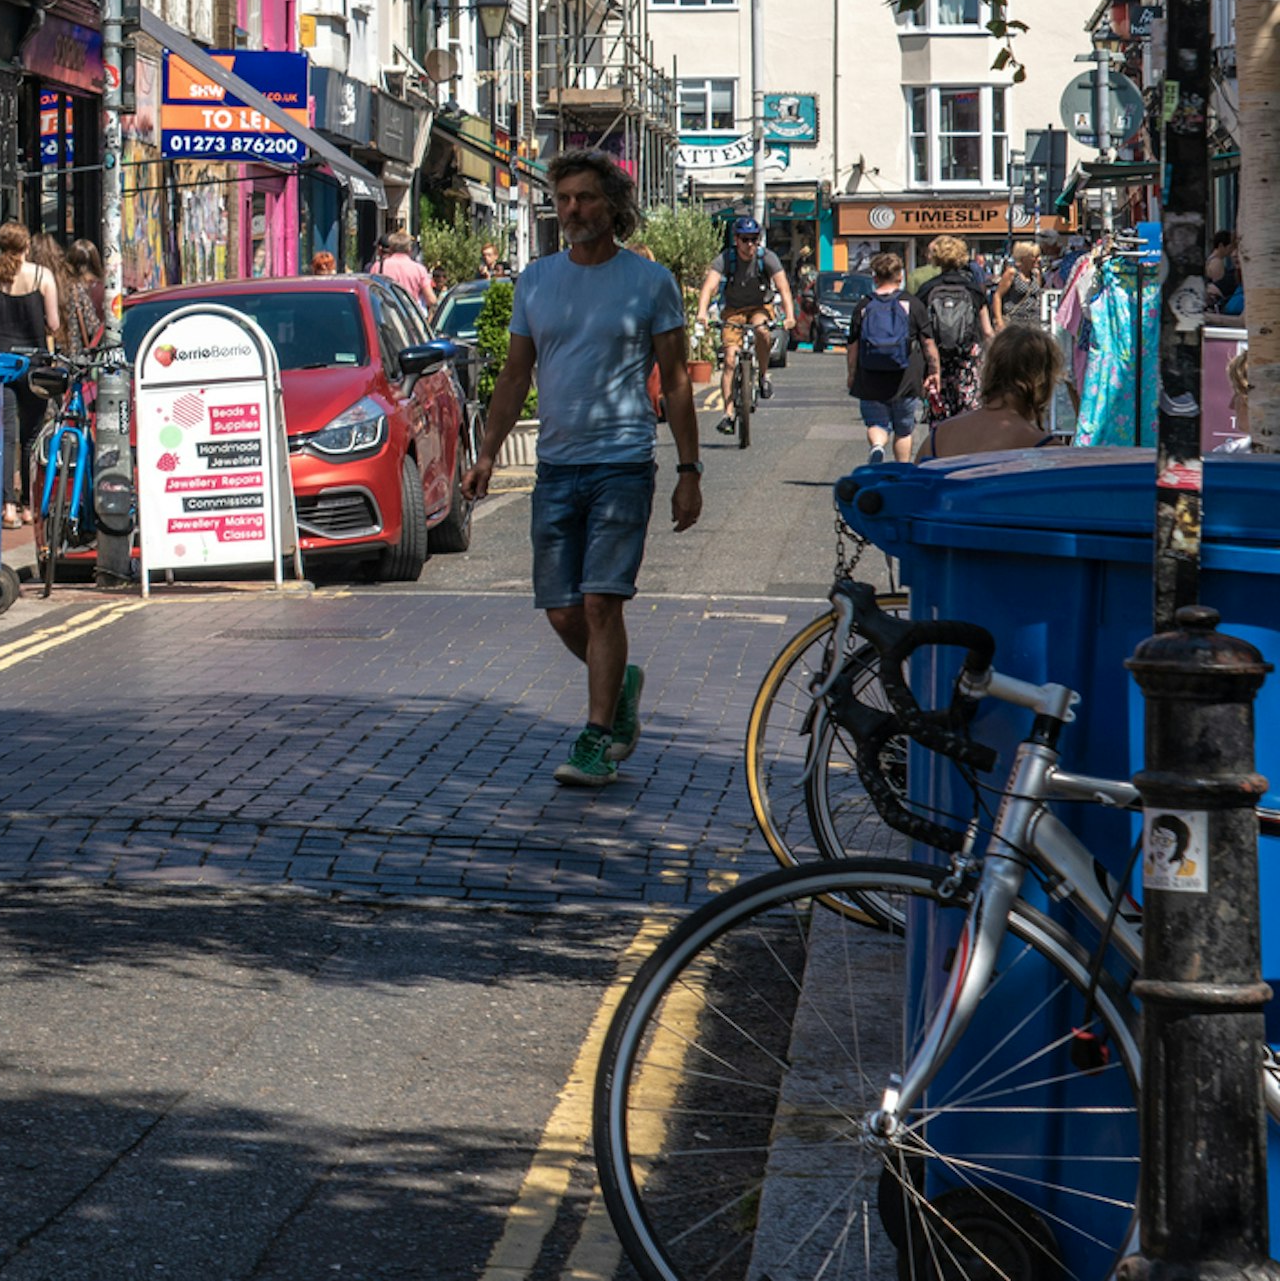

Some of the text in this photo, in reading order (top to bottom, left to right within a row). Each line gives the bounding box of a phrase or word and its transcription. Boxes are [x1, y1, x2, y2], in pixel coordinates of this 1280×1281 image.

[201, 109, 233, 130] TO
[170, 135, 298, 154] 01273 876200
[901, 209, 999, 223] TIMESLIP
[211, 406, 258, 419] Beads &
[213, 419, 259, 433] Supplies
[198, 441, 260, 455] Handmade
[210, 454, 260, 468] Jewellery
[166, 474, 262, 492] Jewellery Repairs
[188, 494, 263, 509] Commissions
[170, 515, 264, 532] Jewellery Making
[223, 527, 264, 541] Classes
